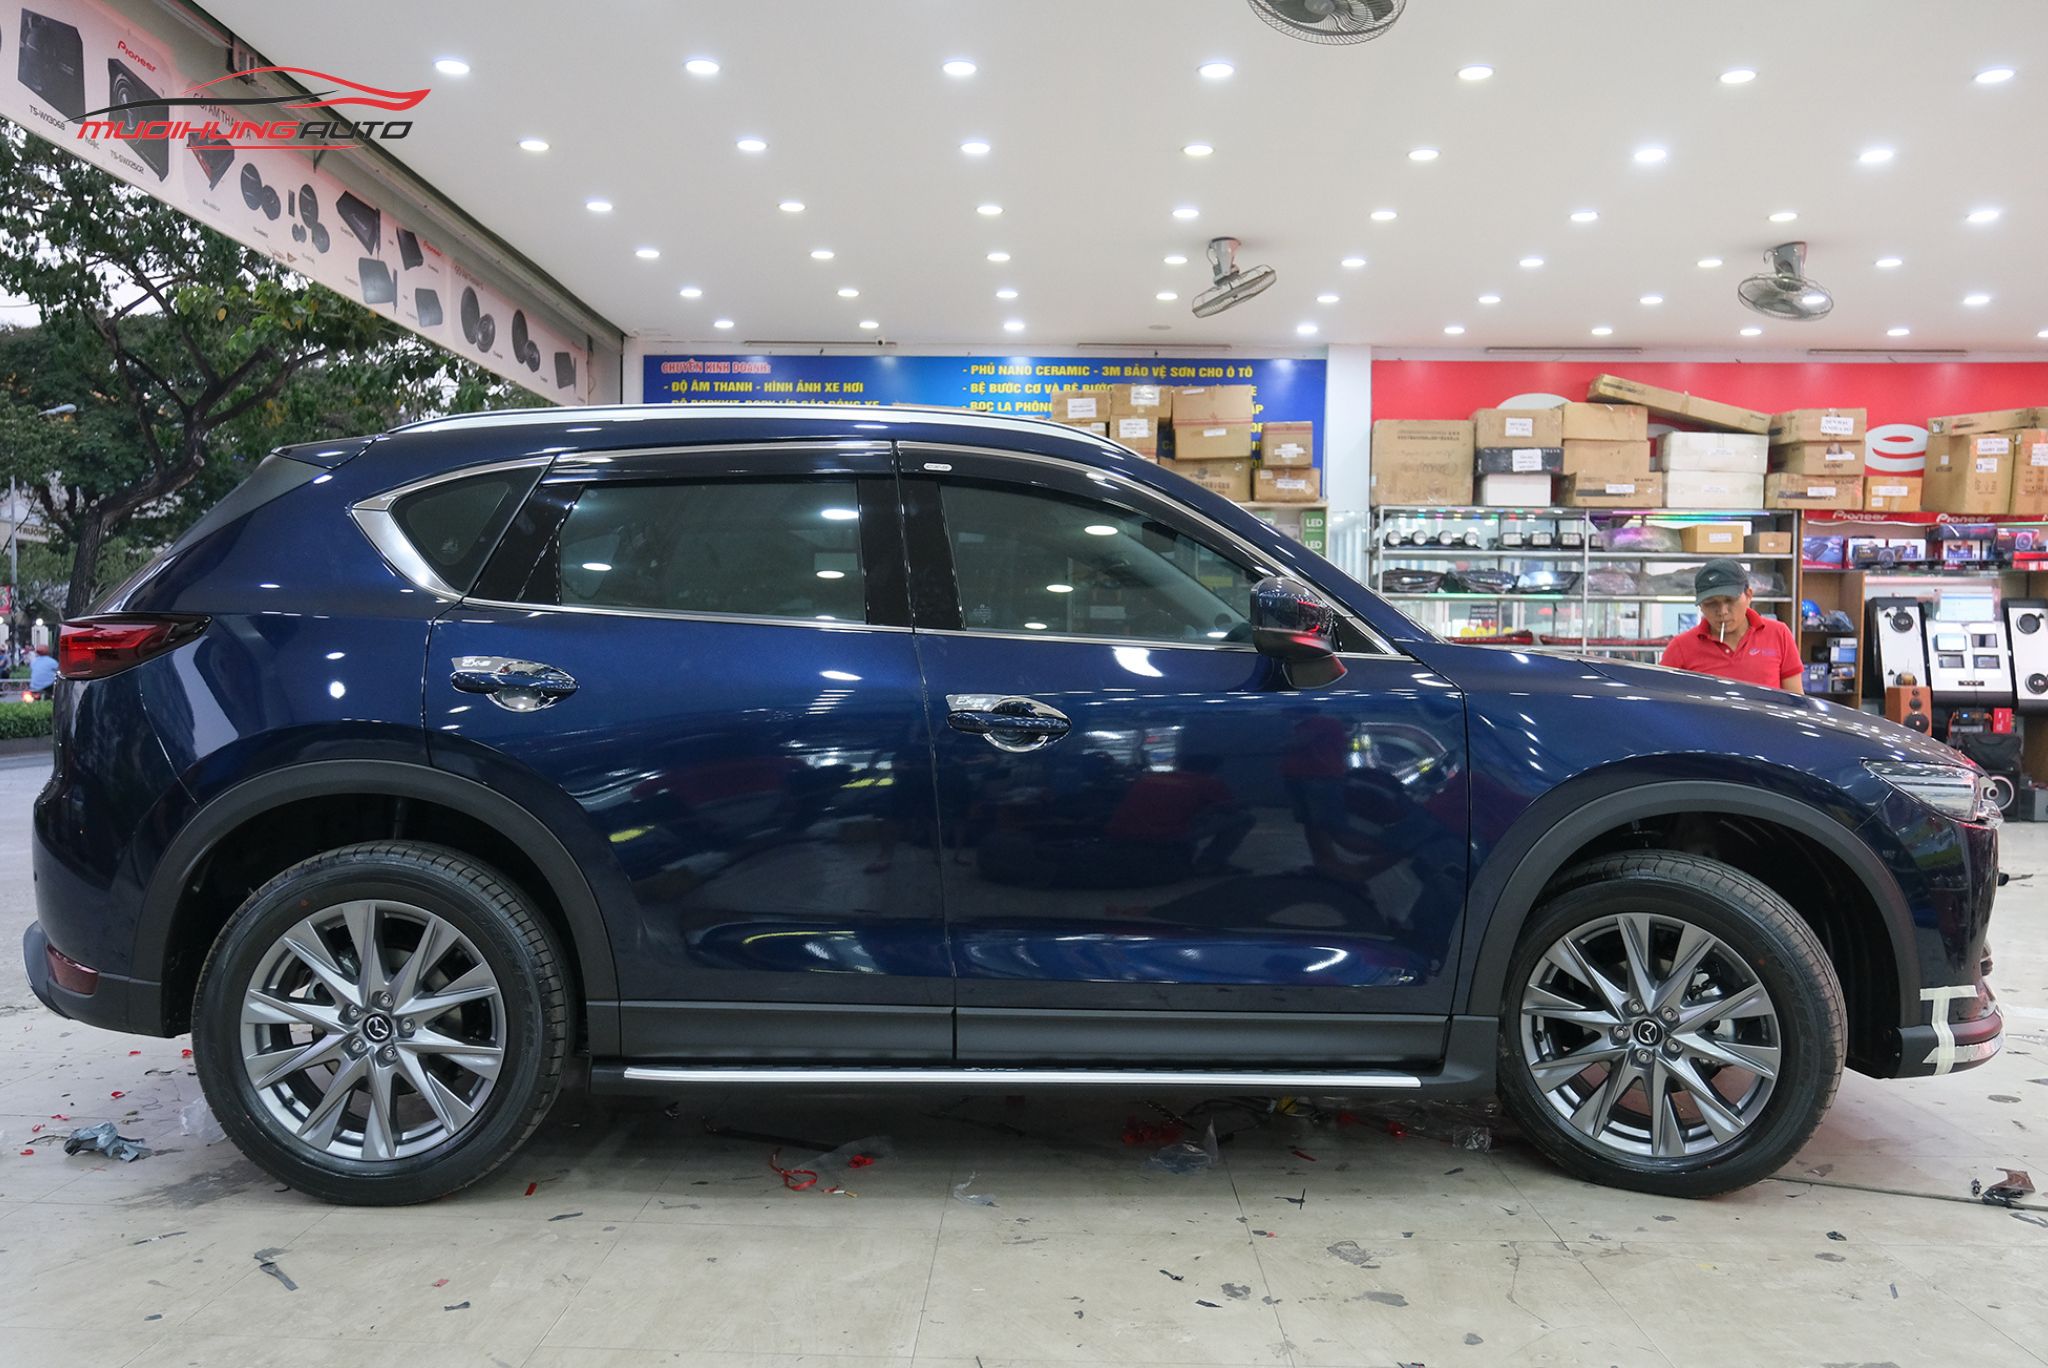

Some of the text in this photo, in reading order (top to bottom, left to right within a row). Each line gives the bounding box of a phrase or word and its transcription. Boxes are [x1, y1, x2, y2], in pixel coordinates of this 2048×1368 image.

[117, 40, 156, 72] Pioneer
[661, 358, 703, 373] CHUYÊN
[705, 361, 730, 373] KINH
[970, 362, 995, 376] PHỦ
[998, 365, 1033, 375] NANO
[1036, 365, 1090, 376] CERAMIC
[1101, 366, 1121, 376] 3M
[1124, 363, 1149, 376] BẢO
[1152, 365, 1167, 379] VỆ
[1170, 366, 1196, 377] SƠN
[1199, 367, 1224, 378] CHO
[1226, 364, 1235, 378] Ô
[1238, 364, 1253, 378] TÔ
[671, 379, 688, 393] ĐỘ
[690, 379, 711, 391] ÂM
[713, 382, 753, 391] THANH
[764, 380, 793, 391] HÌNH
[824, 382, 840, 392] XE
[842, 382, 864, 392] HƠI
[1025, 384, 1042, 394] CƠ
[997, 401, 1013, 411] LA
[1832, 510, 1888, 521] Pioneer
[1936, 513, 1991, 523] Pioneer
[1306, 518, 1323, 528] LED
[1305, 540, 1322, 549] LED
